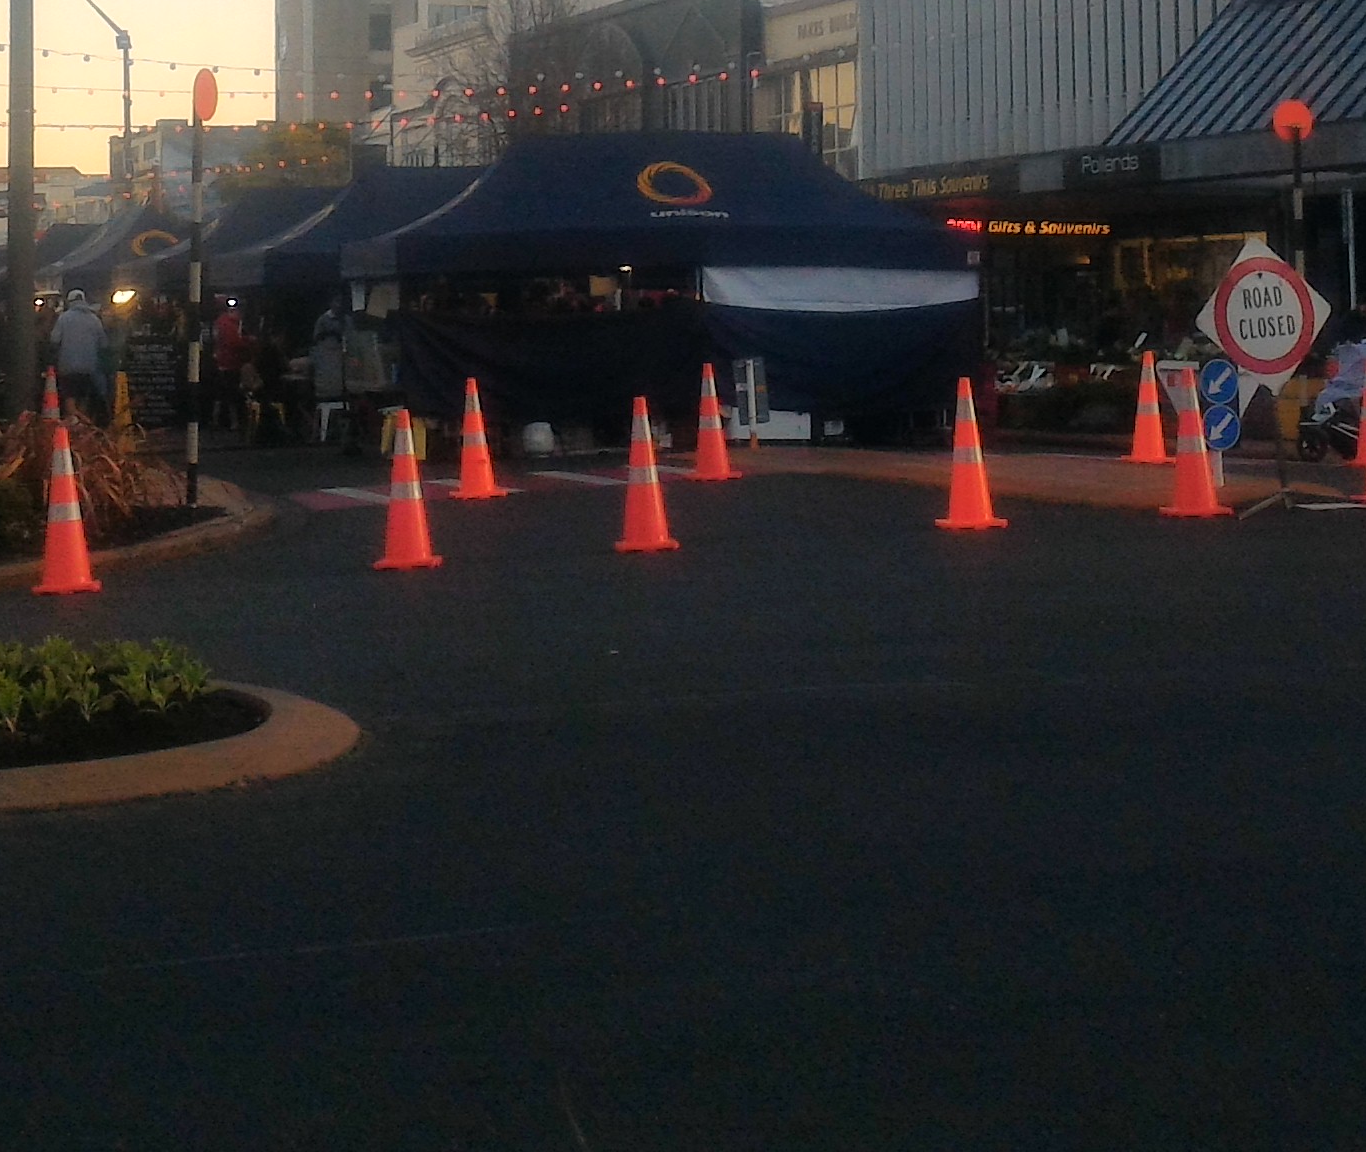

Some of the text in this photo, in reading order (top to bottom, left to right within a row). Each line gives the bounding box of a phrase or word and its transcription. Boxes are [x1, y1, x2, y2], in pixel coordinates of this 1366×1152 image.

[878, 182, 908, 198] Three
[939, 173, 989, 195] Souvenirs
[650, 209, 730, 219] unison
[987, 220, 1022, 234] Gifts
[1023, 221, 1037, 234] &
[1038, 220, 1112, 235] Souvenirs
[1243, 286, 1284, 310] ROAD
[1239, 314, 1296, 341] CLOSED
